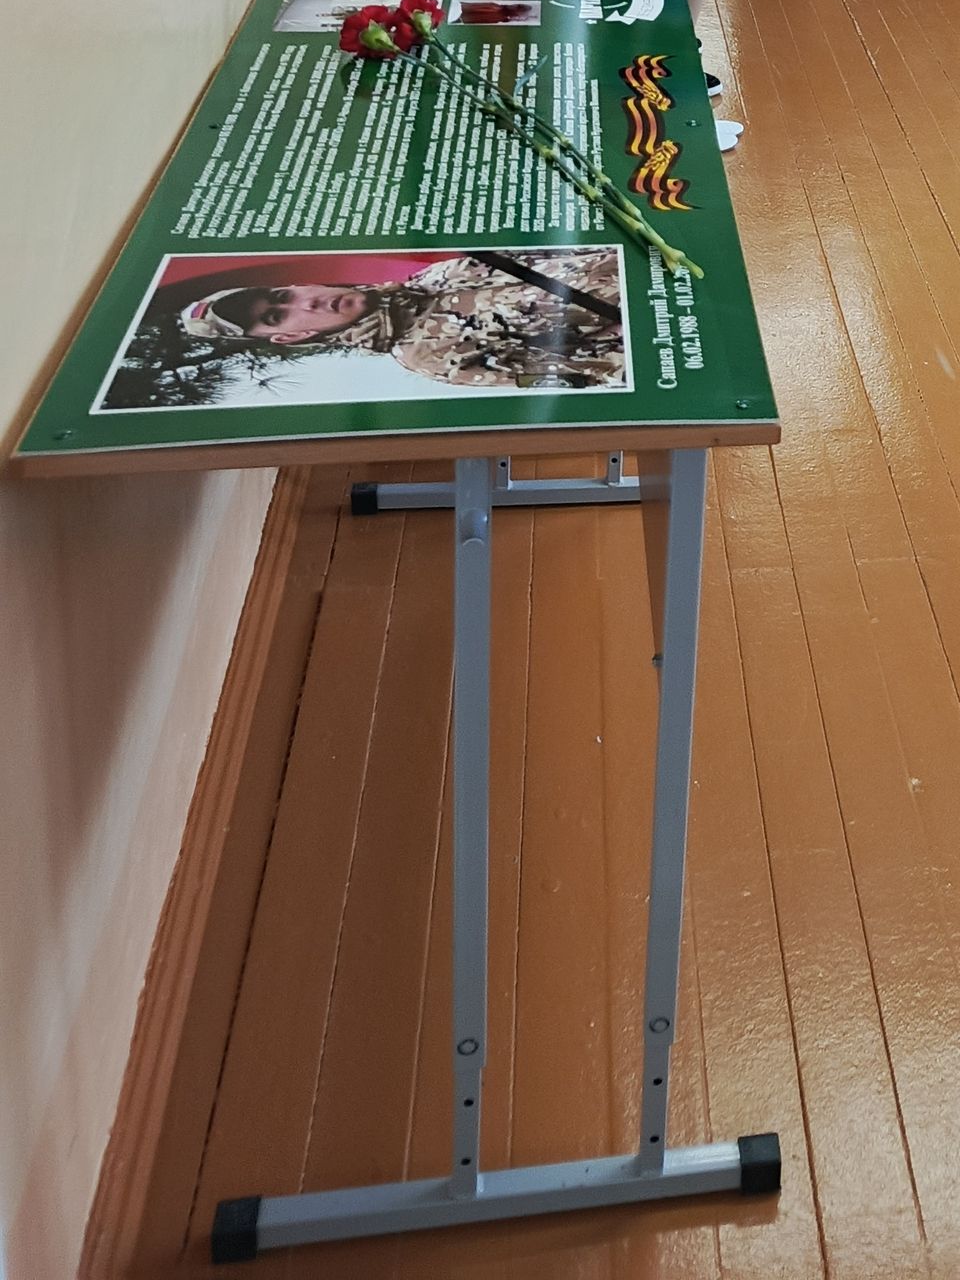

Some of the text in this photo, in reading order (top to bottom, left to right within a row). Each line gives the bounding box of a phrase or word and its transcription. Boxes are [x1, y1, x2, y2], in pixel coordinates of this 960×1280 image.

[648, 298, 676, 346] Дмитрий
[676, 314, 705, 369] 06.02.1988
[652, 346, 681, 389] Сапаев
